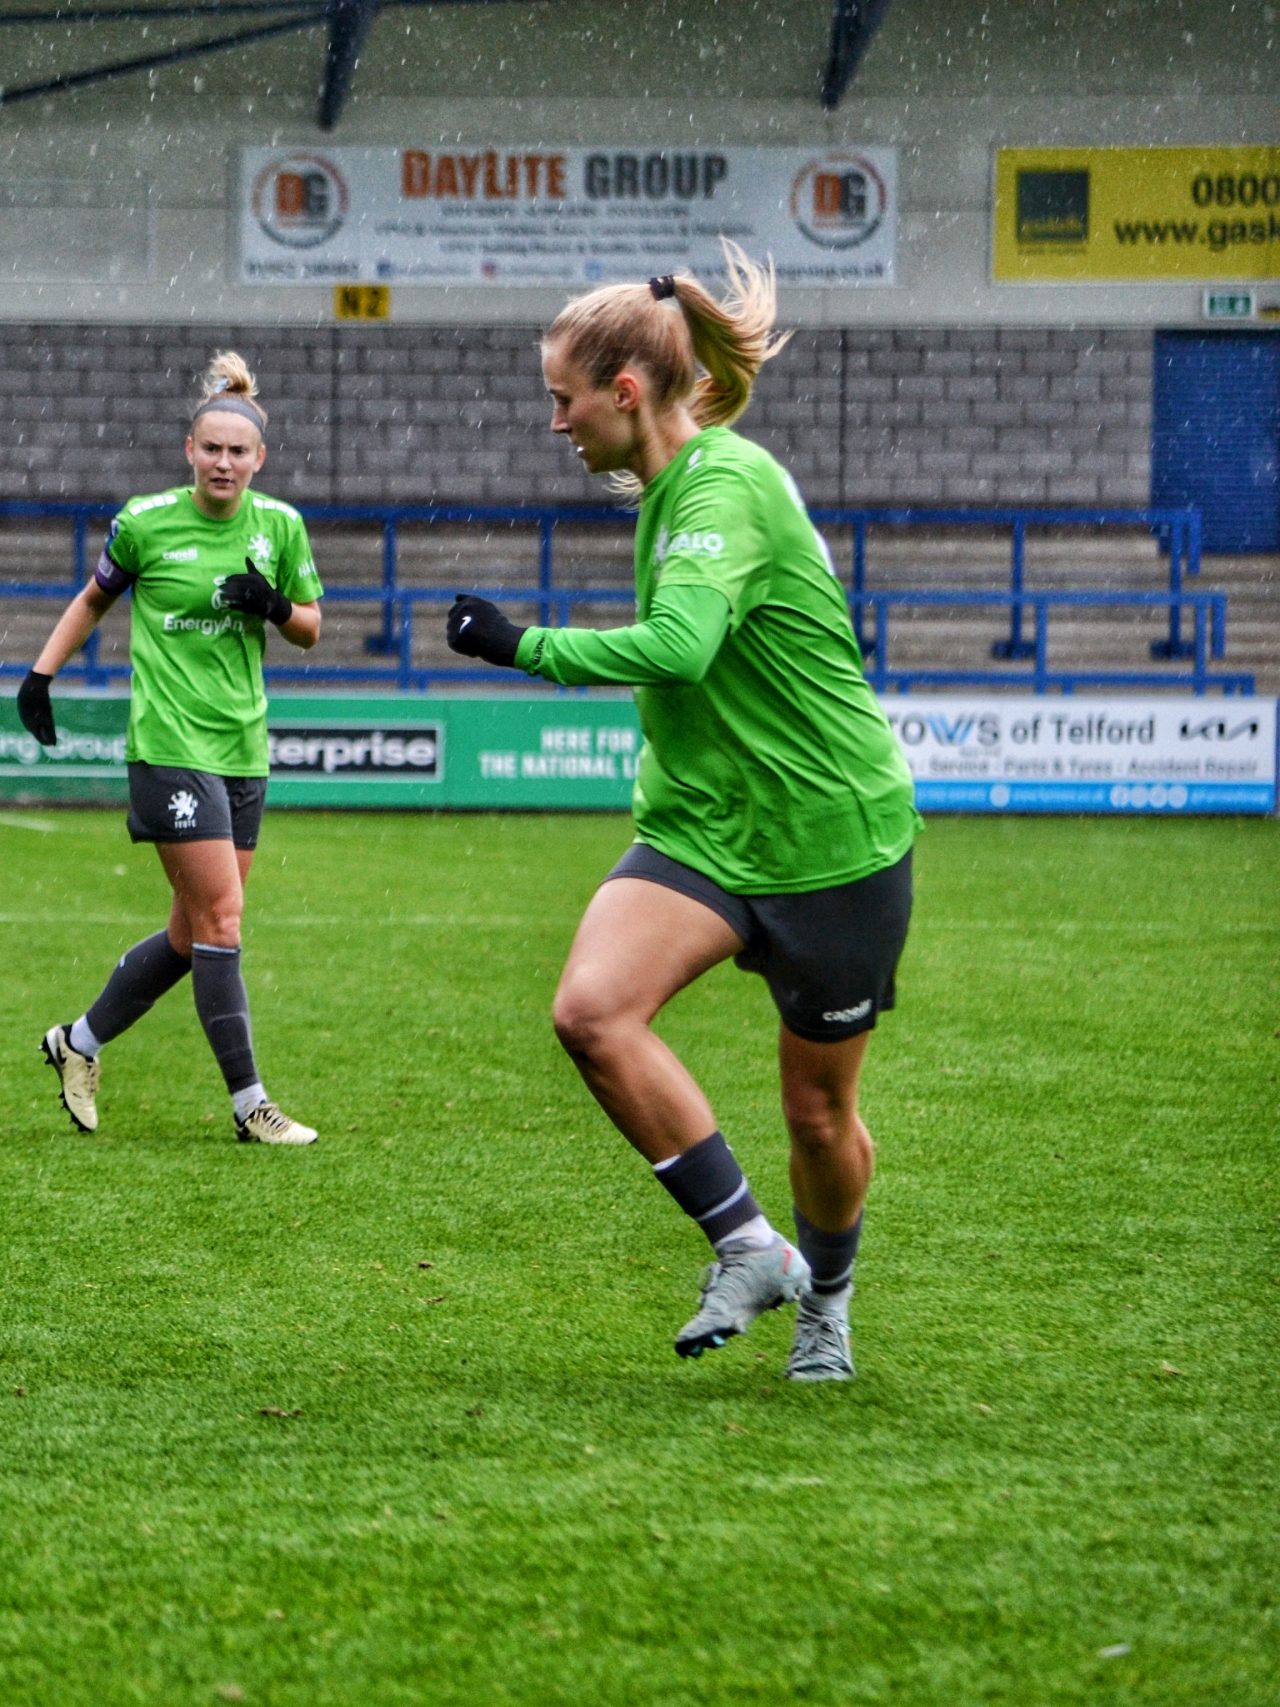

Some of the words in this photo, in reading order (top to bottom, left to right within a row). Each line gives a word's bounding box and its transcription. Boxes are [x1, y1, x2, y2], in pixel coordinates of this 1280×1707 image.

[584, 153, 727, 201] GROUP
[1192, 173, 1280, 208] 0800
[341, 285, 384, 318] N2
[162, 548, 198, 562] capelli
[669, 532, 724, 552] ALO
[164, 613, 244, 636] EnergyAn
[540, 726, 592, 752] HERE
[596, 726, 636, 753] FOR
[1011, 713, 1039, 745] of
[1049, 712, 1157, 745] Telford
[268, 731, 436, 774] terprise
[480, 750, 517, 779] THE
[522, 752, 616, 780] NATIONAL
